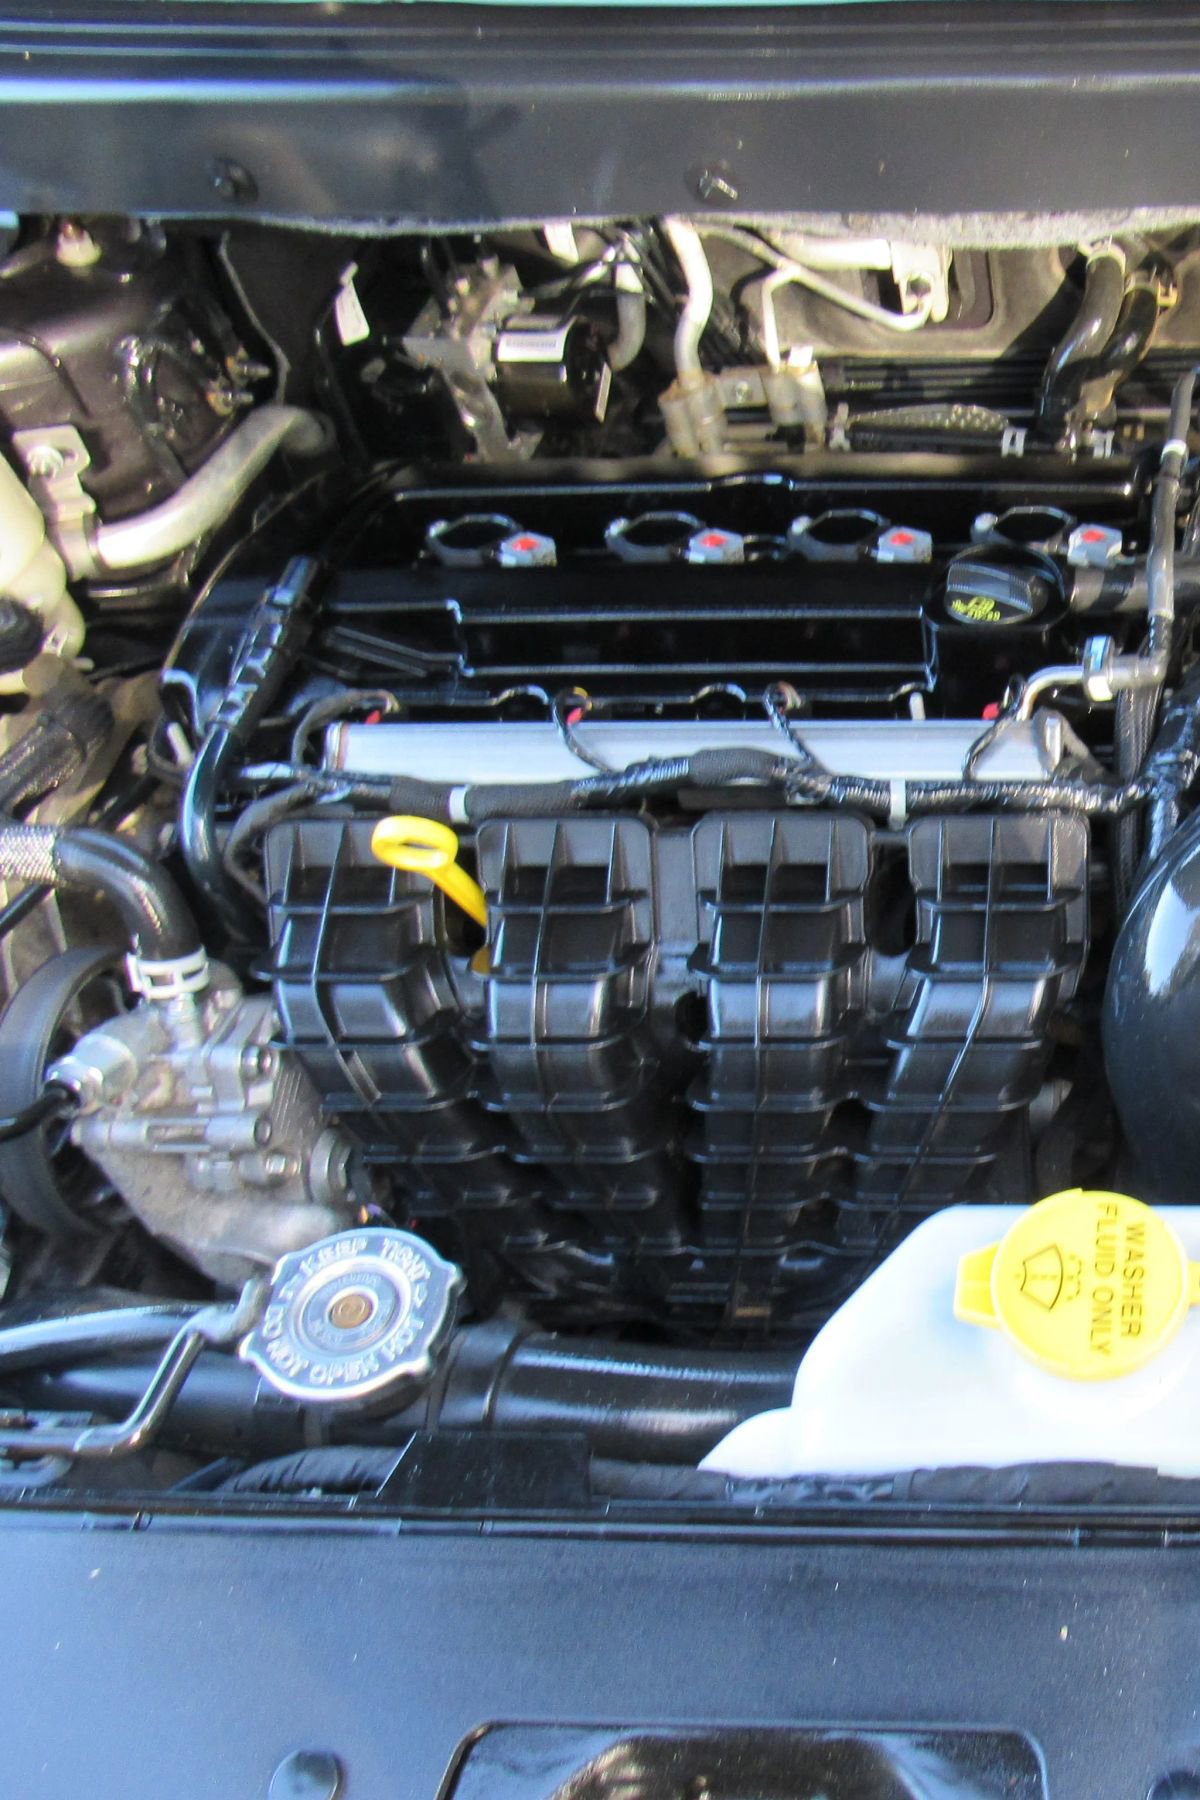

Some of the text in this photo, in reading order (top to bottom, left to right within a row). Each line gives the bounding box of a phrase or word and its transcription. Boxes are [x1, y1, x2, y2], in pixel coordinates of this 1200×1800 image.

[300, 1237, 368, 1274] KEEP
[1089, 1202, 1119, 1356] FLUID ONLY
[1120, 1223, 1145, 1338] WASHER
[262, 1305, 284, 1339] DO
[381, 1314, 425, 1361] HOT
[266, 1340, 310, 1377] NOT
[309, 1352, 380, 1385] OPEN
